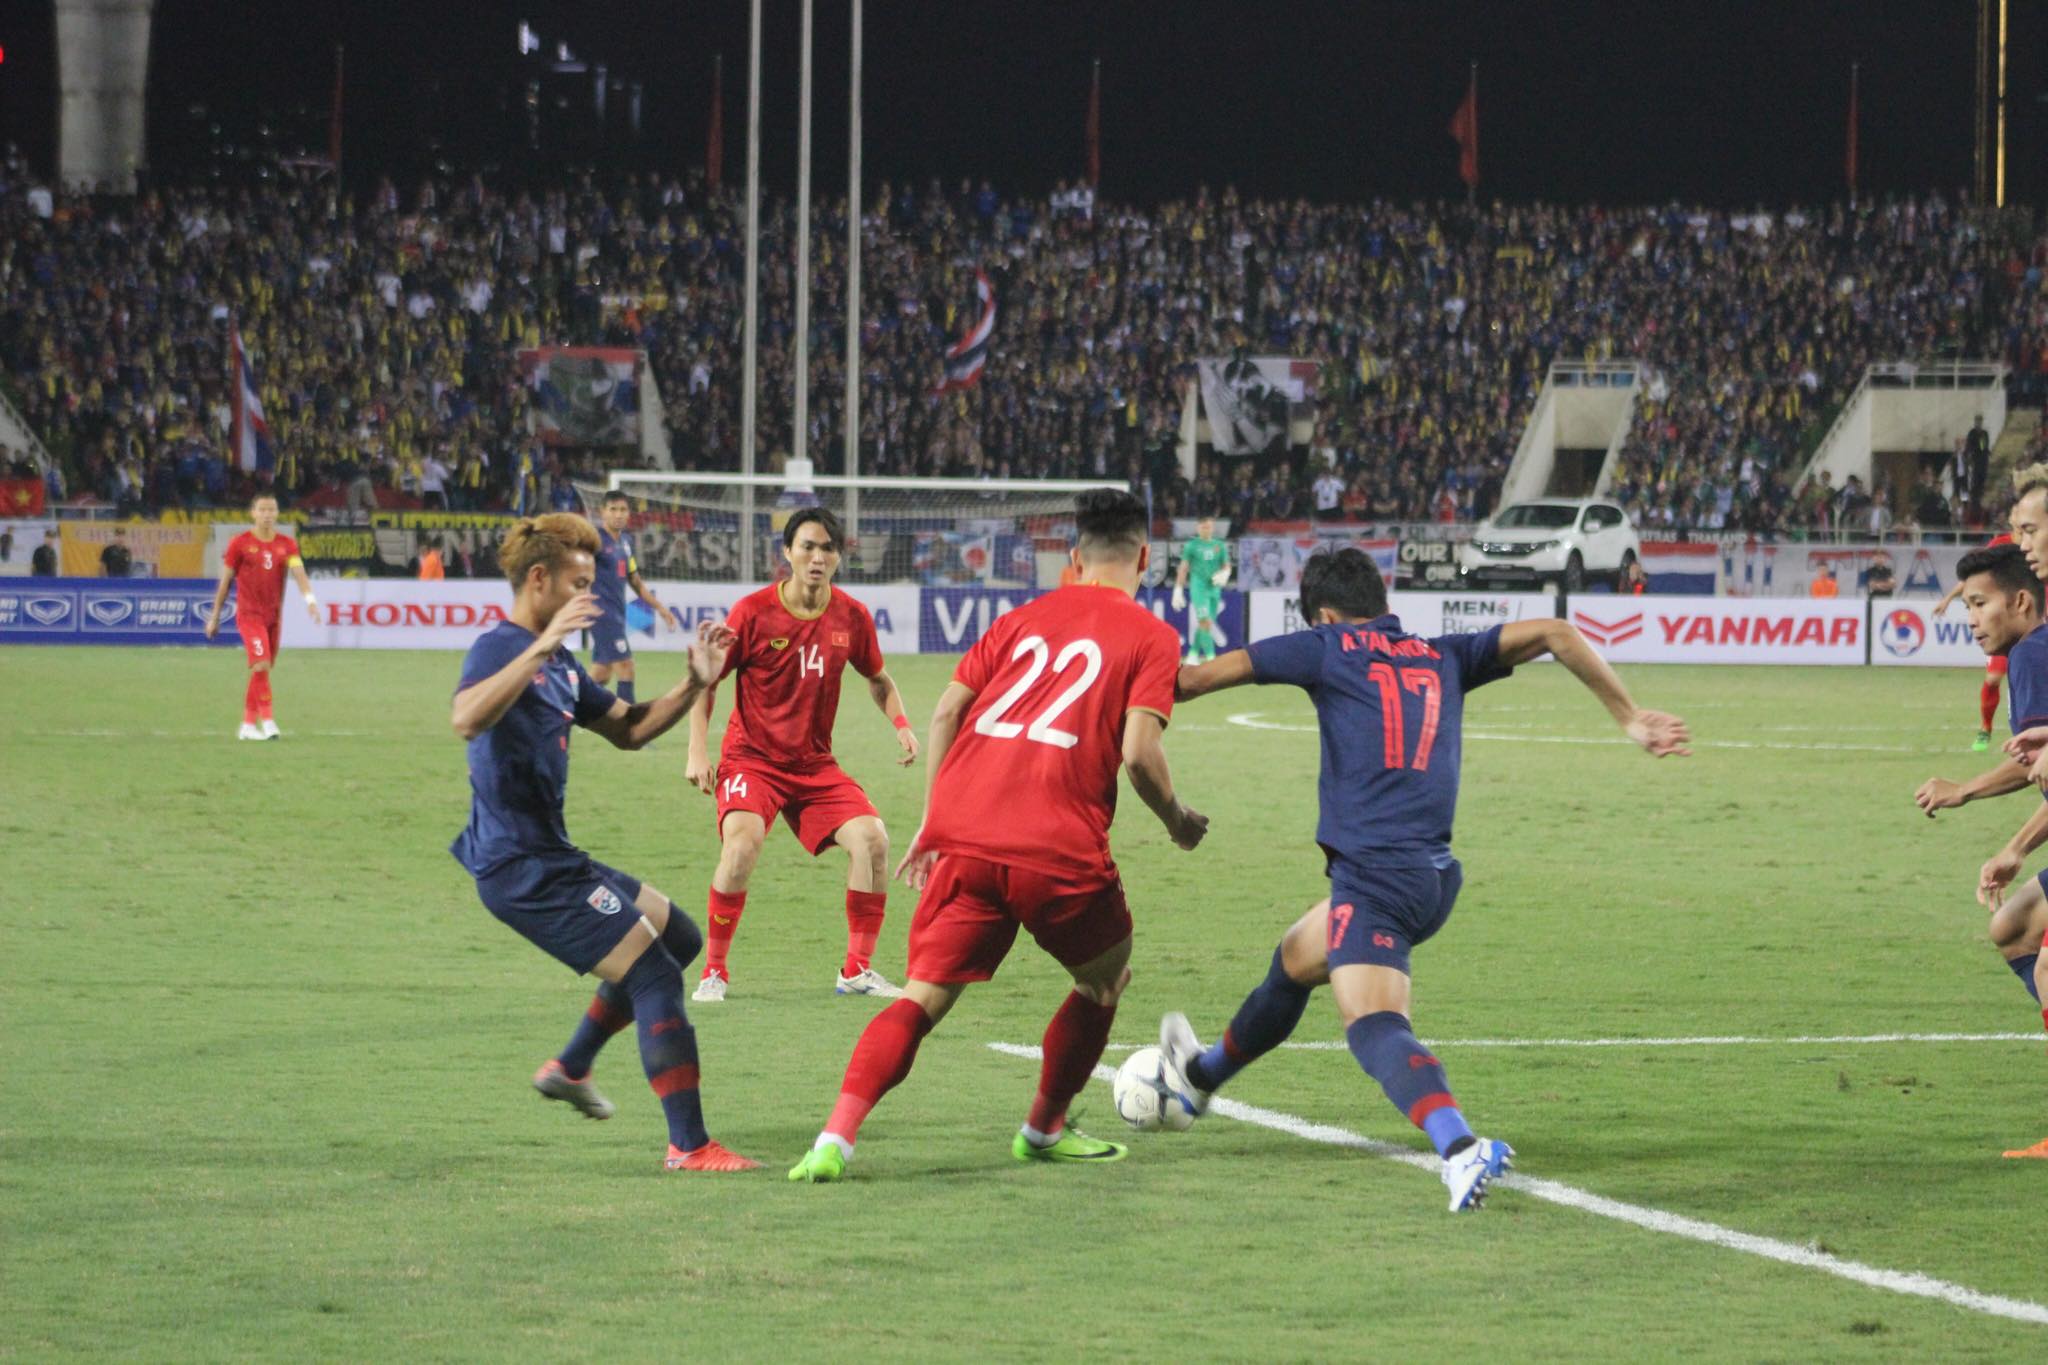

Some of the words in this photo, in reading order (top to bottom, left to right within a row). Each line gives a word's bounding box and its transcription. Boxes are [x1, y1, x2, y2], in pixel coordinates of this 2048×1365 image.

[263, 551, 273, 570] 3
[140, 600, 187, 612] GRAND
[326, 603, 508, 627] HONDA
[140, 614, 184, 625] SPORT
[1658, 616, 1859, 646] YANMAR
[253, 637, 264, 656] 3
[798, 644, 825, 680] 14
[974, 635, 1102, 749] 22
[1367, 662, 1442, 772] 17
[723, 773, 748, 802] 14
